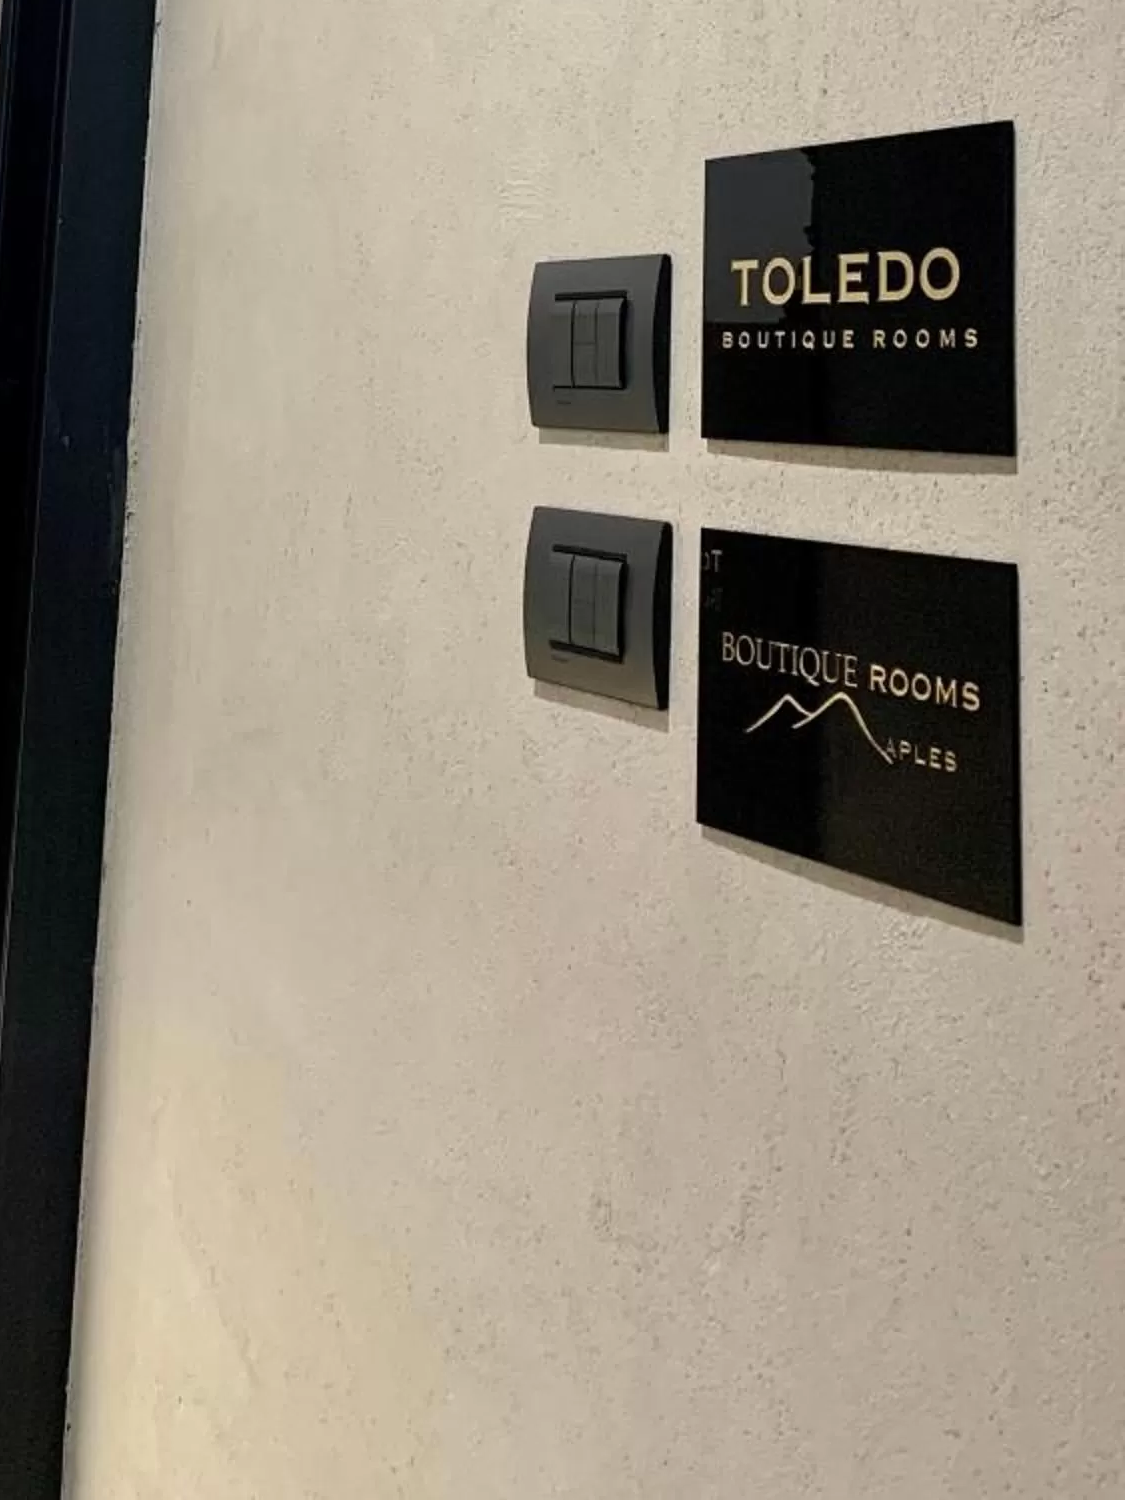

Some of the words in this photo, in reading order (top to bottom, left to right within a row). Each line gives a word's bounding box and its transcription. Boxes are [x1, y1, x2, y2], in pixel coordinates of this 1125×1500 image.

[730, 247, 961, 307] TOLEDO
[722, 329, 855, 350] BOUTIQUE
[873, 328, 979, 349] ROOMS
[722, 631, 858, 688] BOUTIQUE
[869, 663, 980, 712] ROOMS
